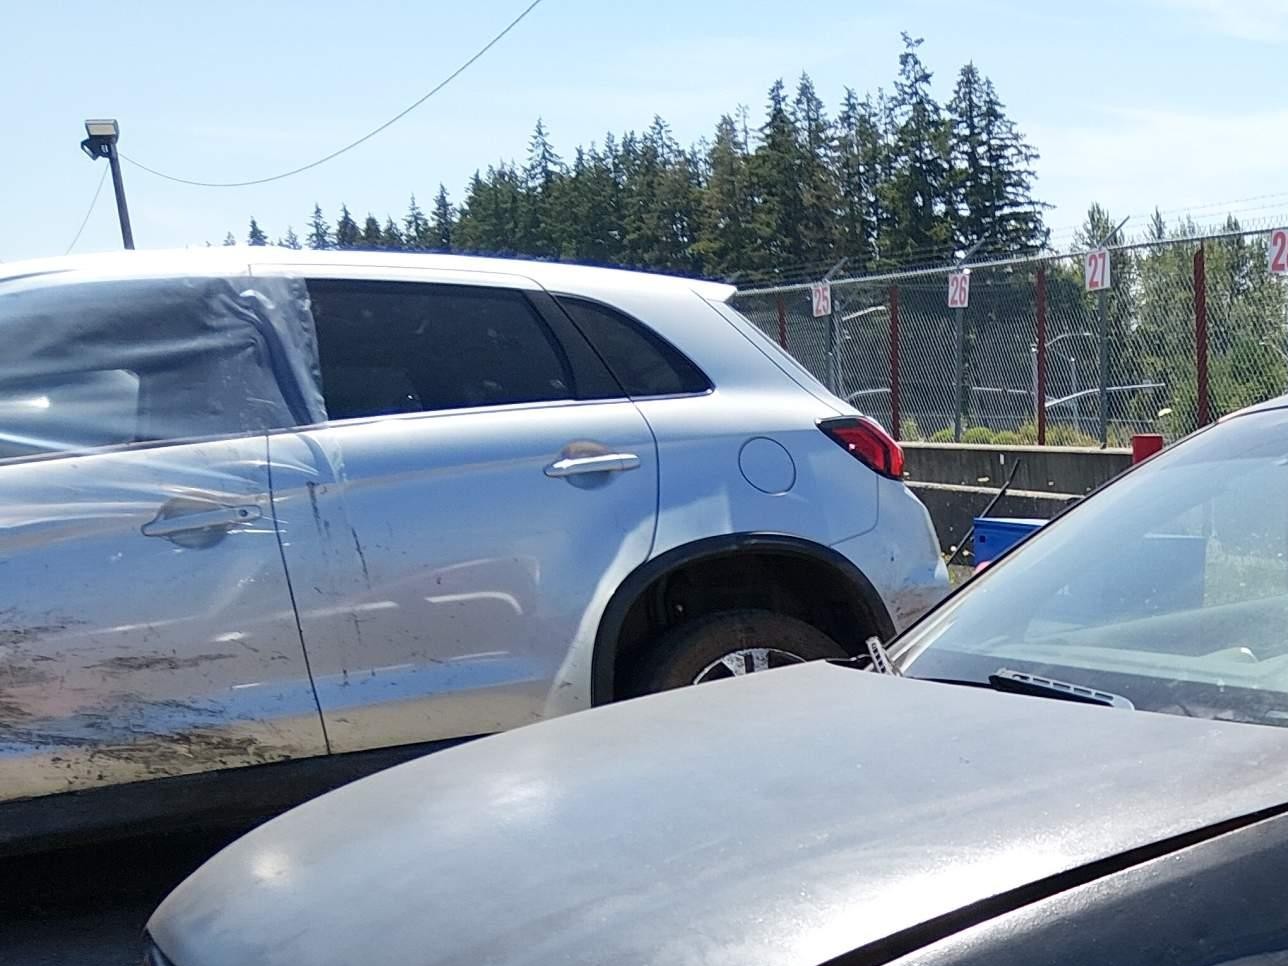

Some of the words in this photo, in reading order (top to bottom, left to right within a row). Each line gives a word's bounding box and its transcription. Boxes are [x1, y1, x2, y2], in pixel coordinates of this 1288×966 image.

[1088, 254, 1106, 289] 27
[814, 287, 829, 315] 25
[949, 275, 967, 306] 26
